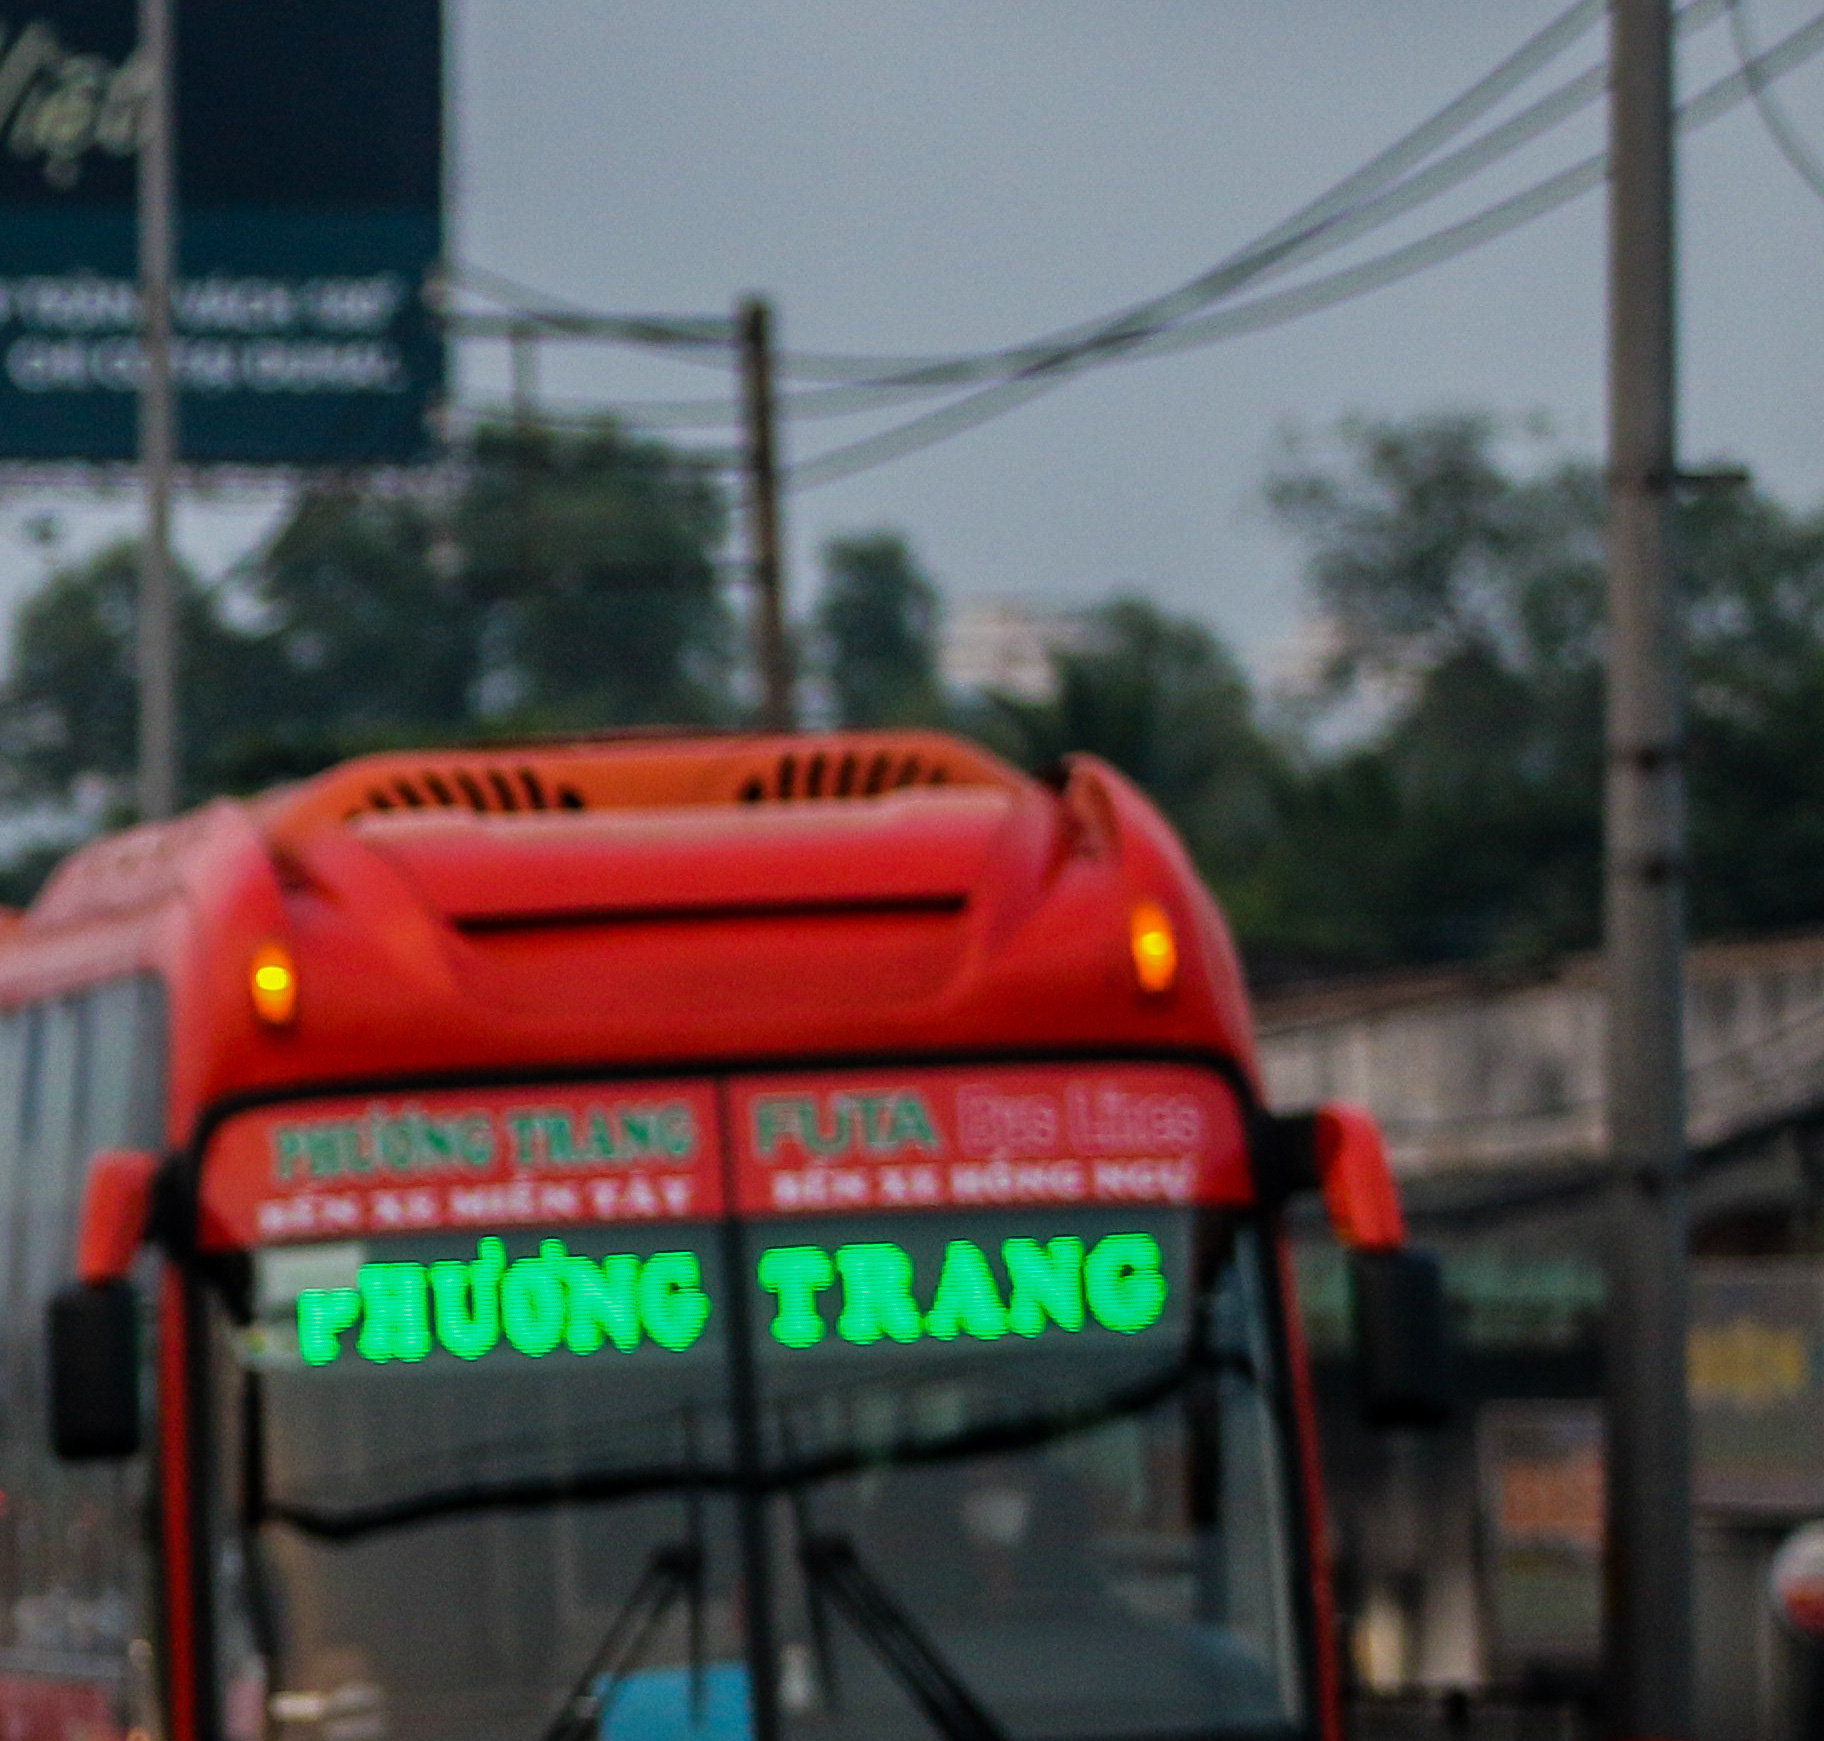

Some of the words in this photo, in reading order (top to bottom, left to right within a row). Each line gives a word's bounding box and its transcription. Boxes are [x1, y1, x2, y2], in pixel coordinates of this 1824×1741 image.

[507, 1104, 695, 1166] TRANG
[752, 1088, 943, 1163] FUTA
[297, 1237, 711, 1366] PHƯƠNG
[758, 1233, 1167, 1348] TRANG
